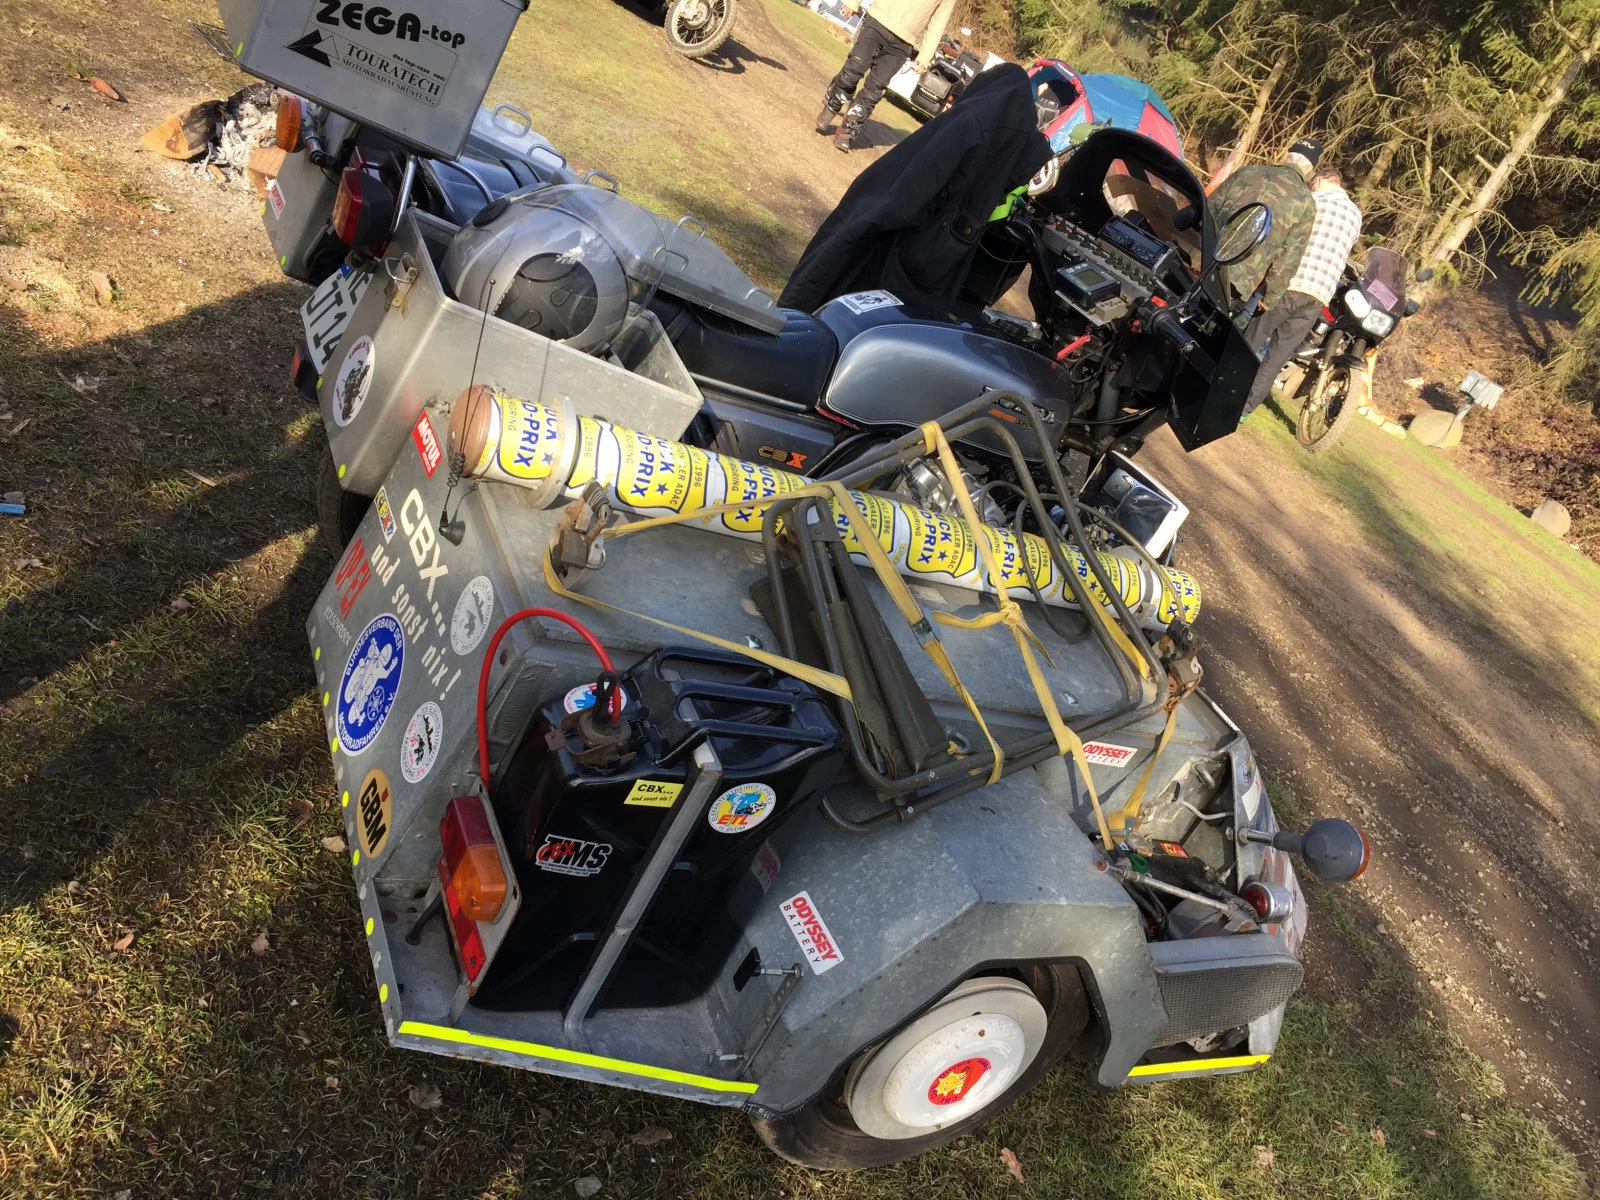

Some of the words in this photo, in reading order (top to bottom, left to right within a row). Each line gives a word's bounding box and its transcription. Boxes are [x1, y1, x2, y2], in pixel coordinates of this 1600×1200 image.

[316, 0, 465, 48] ZEGA-top
[348, 43, 440, 96] TOURATECH
[418, 418, 441, 468] MOTUL
[693, 466, 703, 487] 1996
[883, 515, 891, 534] 1996
[966, 533, 974, 553] 1996
[948, 549, 961, 569] ADAC
[371, 545, 400, 587] und
[391, 583, 428, 645] sonst
[345, 618, 396, 676] BUNDESVERBAND
[393, 625, 403, 653] DER
[338, 711, 388, 751] MOTORRADFAHRER
[1083, 744, 1132, 759] ODYSSEY
[1084, 755, 1121, 765] ATTERY
[637, 783, 674, 795] CBX...
[360, 777, 387, 853] GBM
[716, 814, 749, 825] ETL
[783, 904, 821, 964] BATTERY
[792, 896, 839, 961] ODYSSEY
